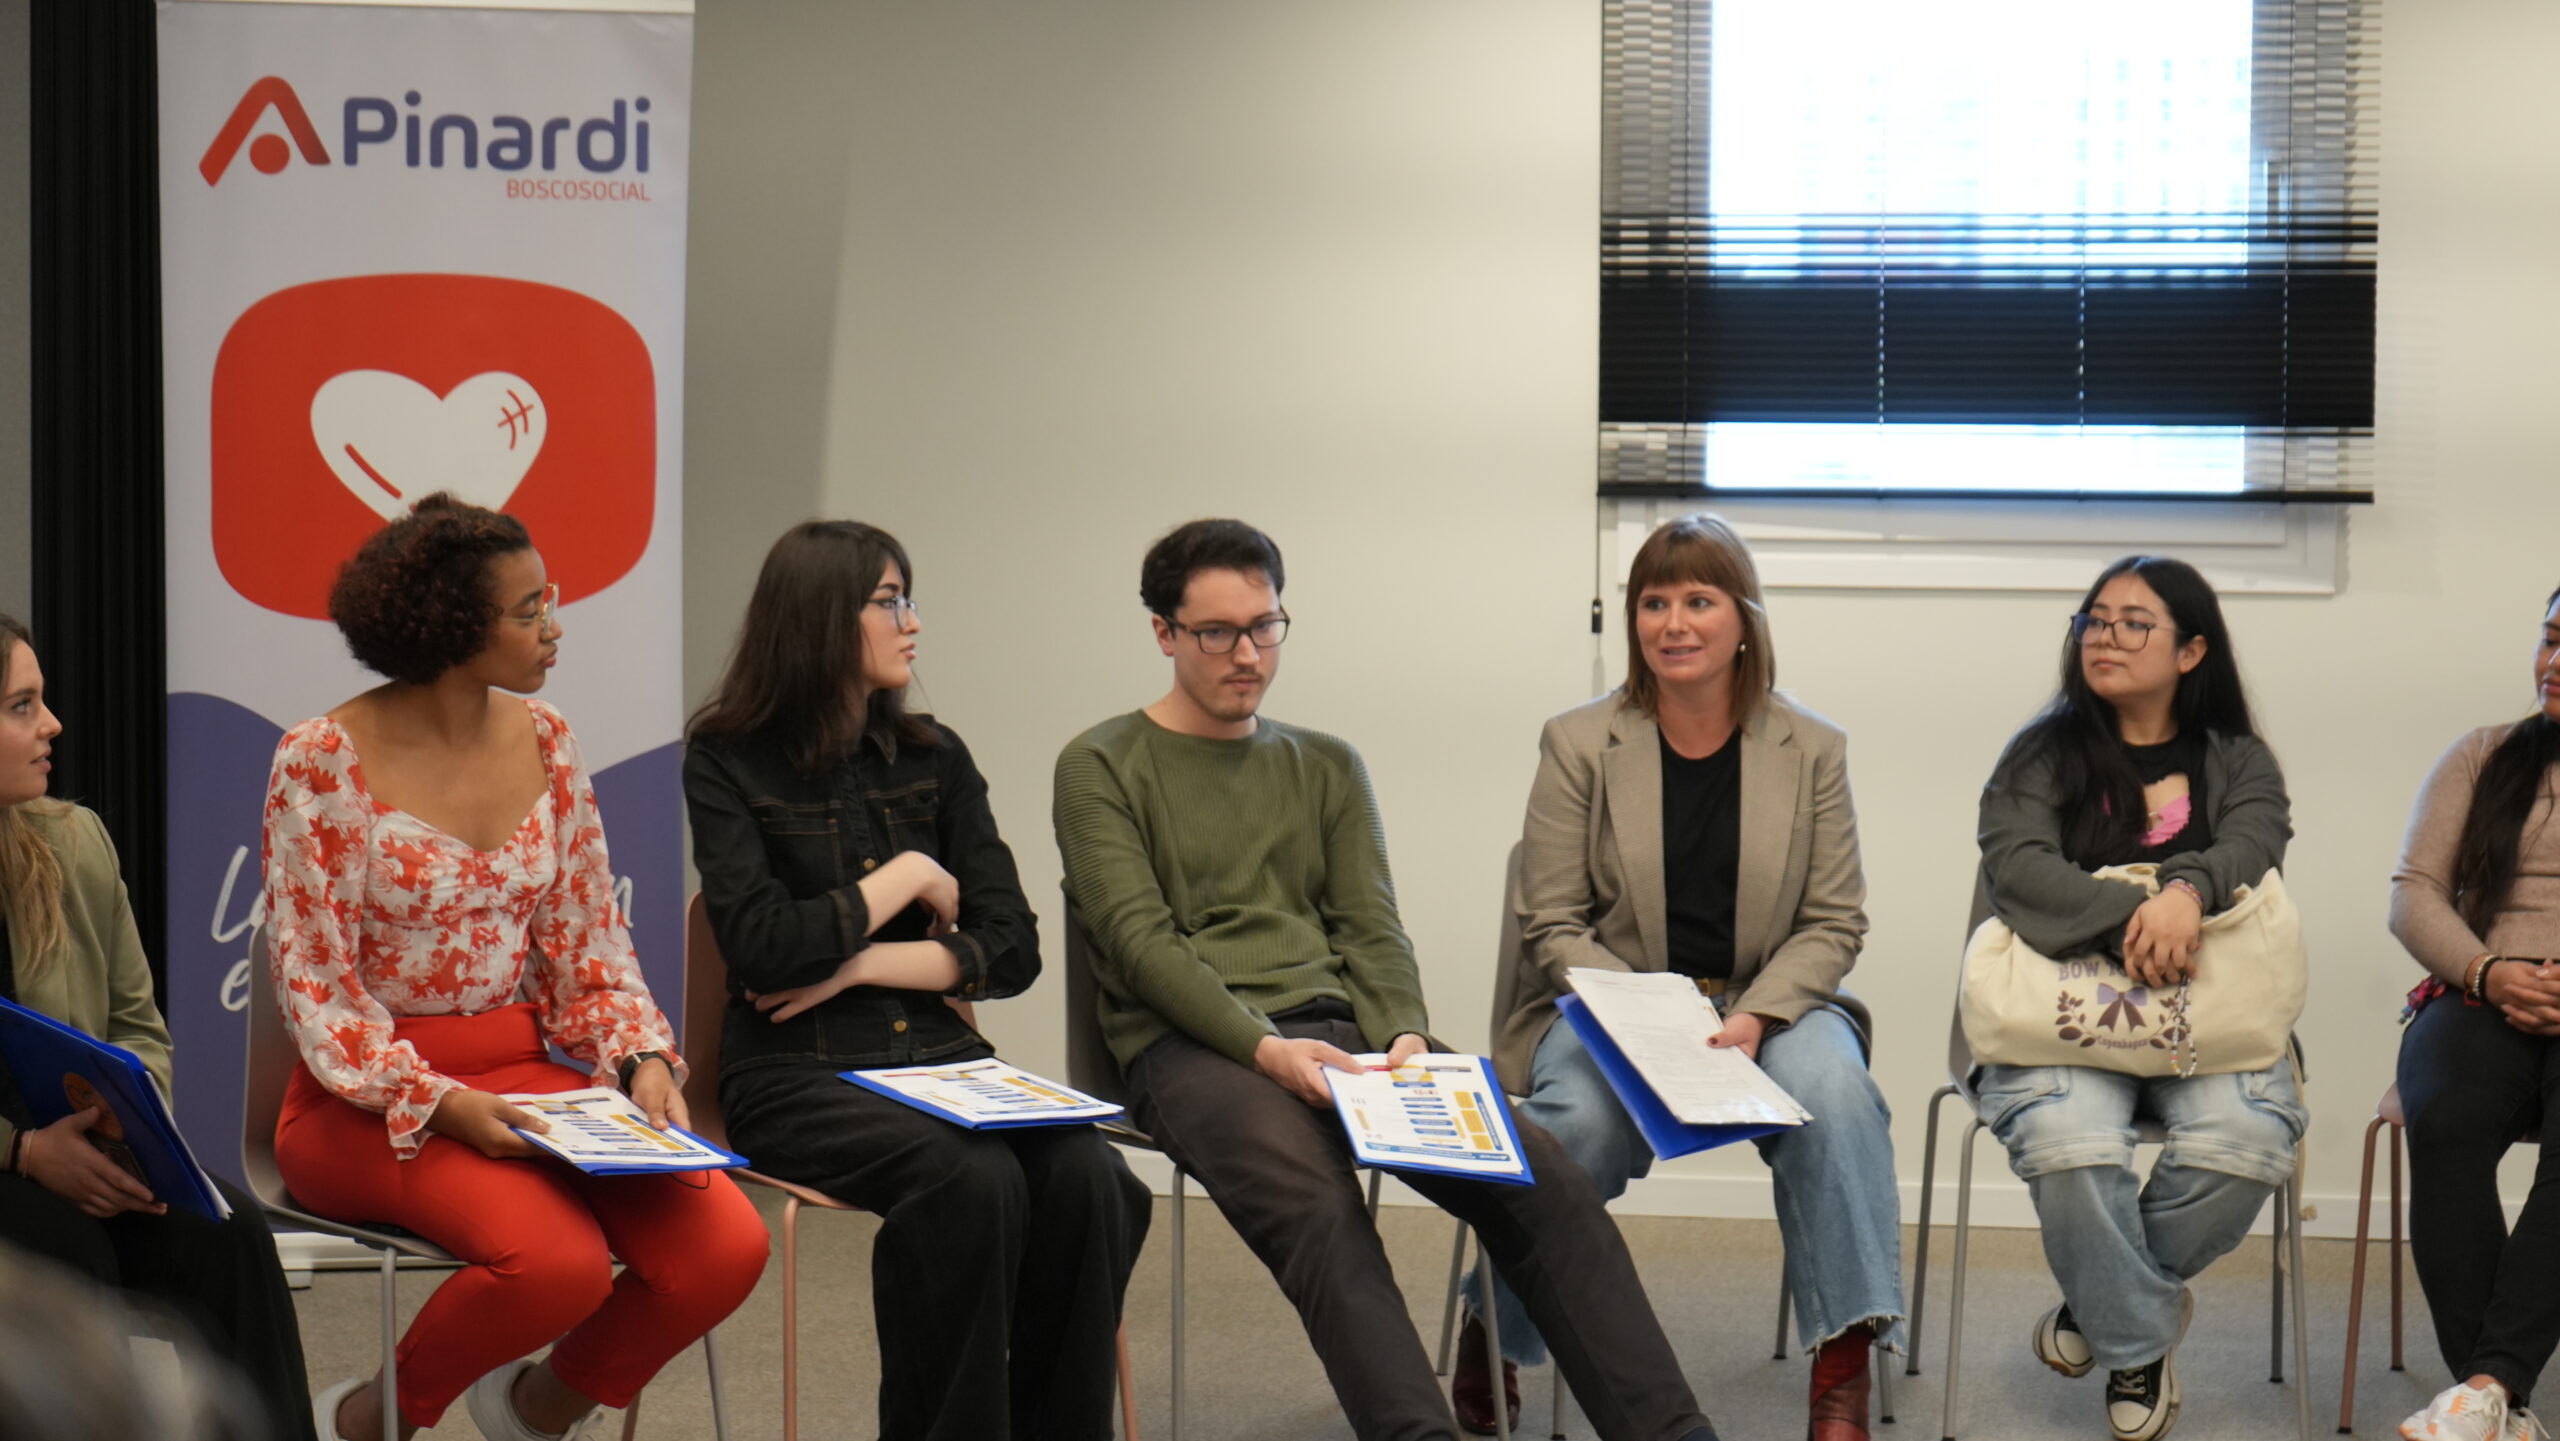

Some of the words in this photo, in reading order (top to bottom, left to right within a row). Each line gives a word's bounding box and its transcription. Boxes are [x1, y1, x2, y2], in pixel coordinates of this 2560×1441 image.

[344, 90, 651, 174] Pinardi
[506, 178, 652, 201] BOSCOSOCIAL
[2058, 960, 2099, 981] BOW
